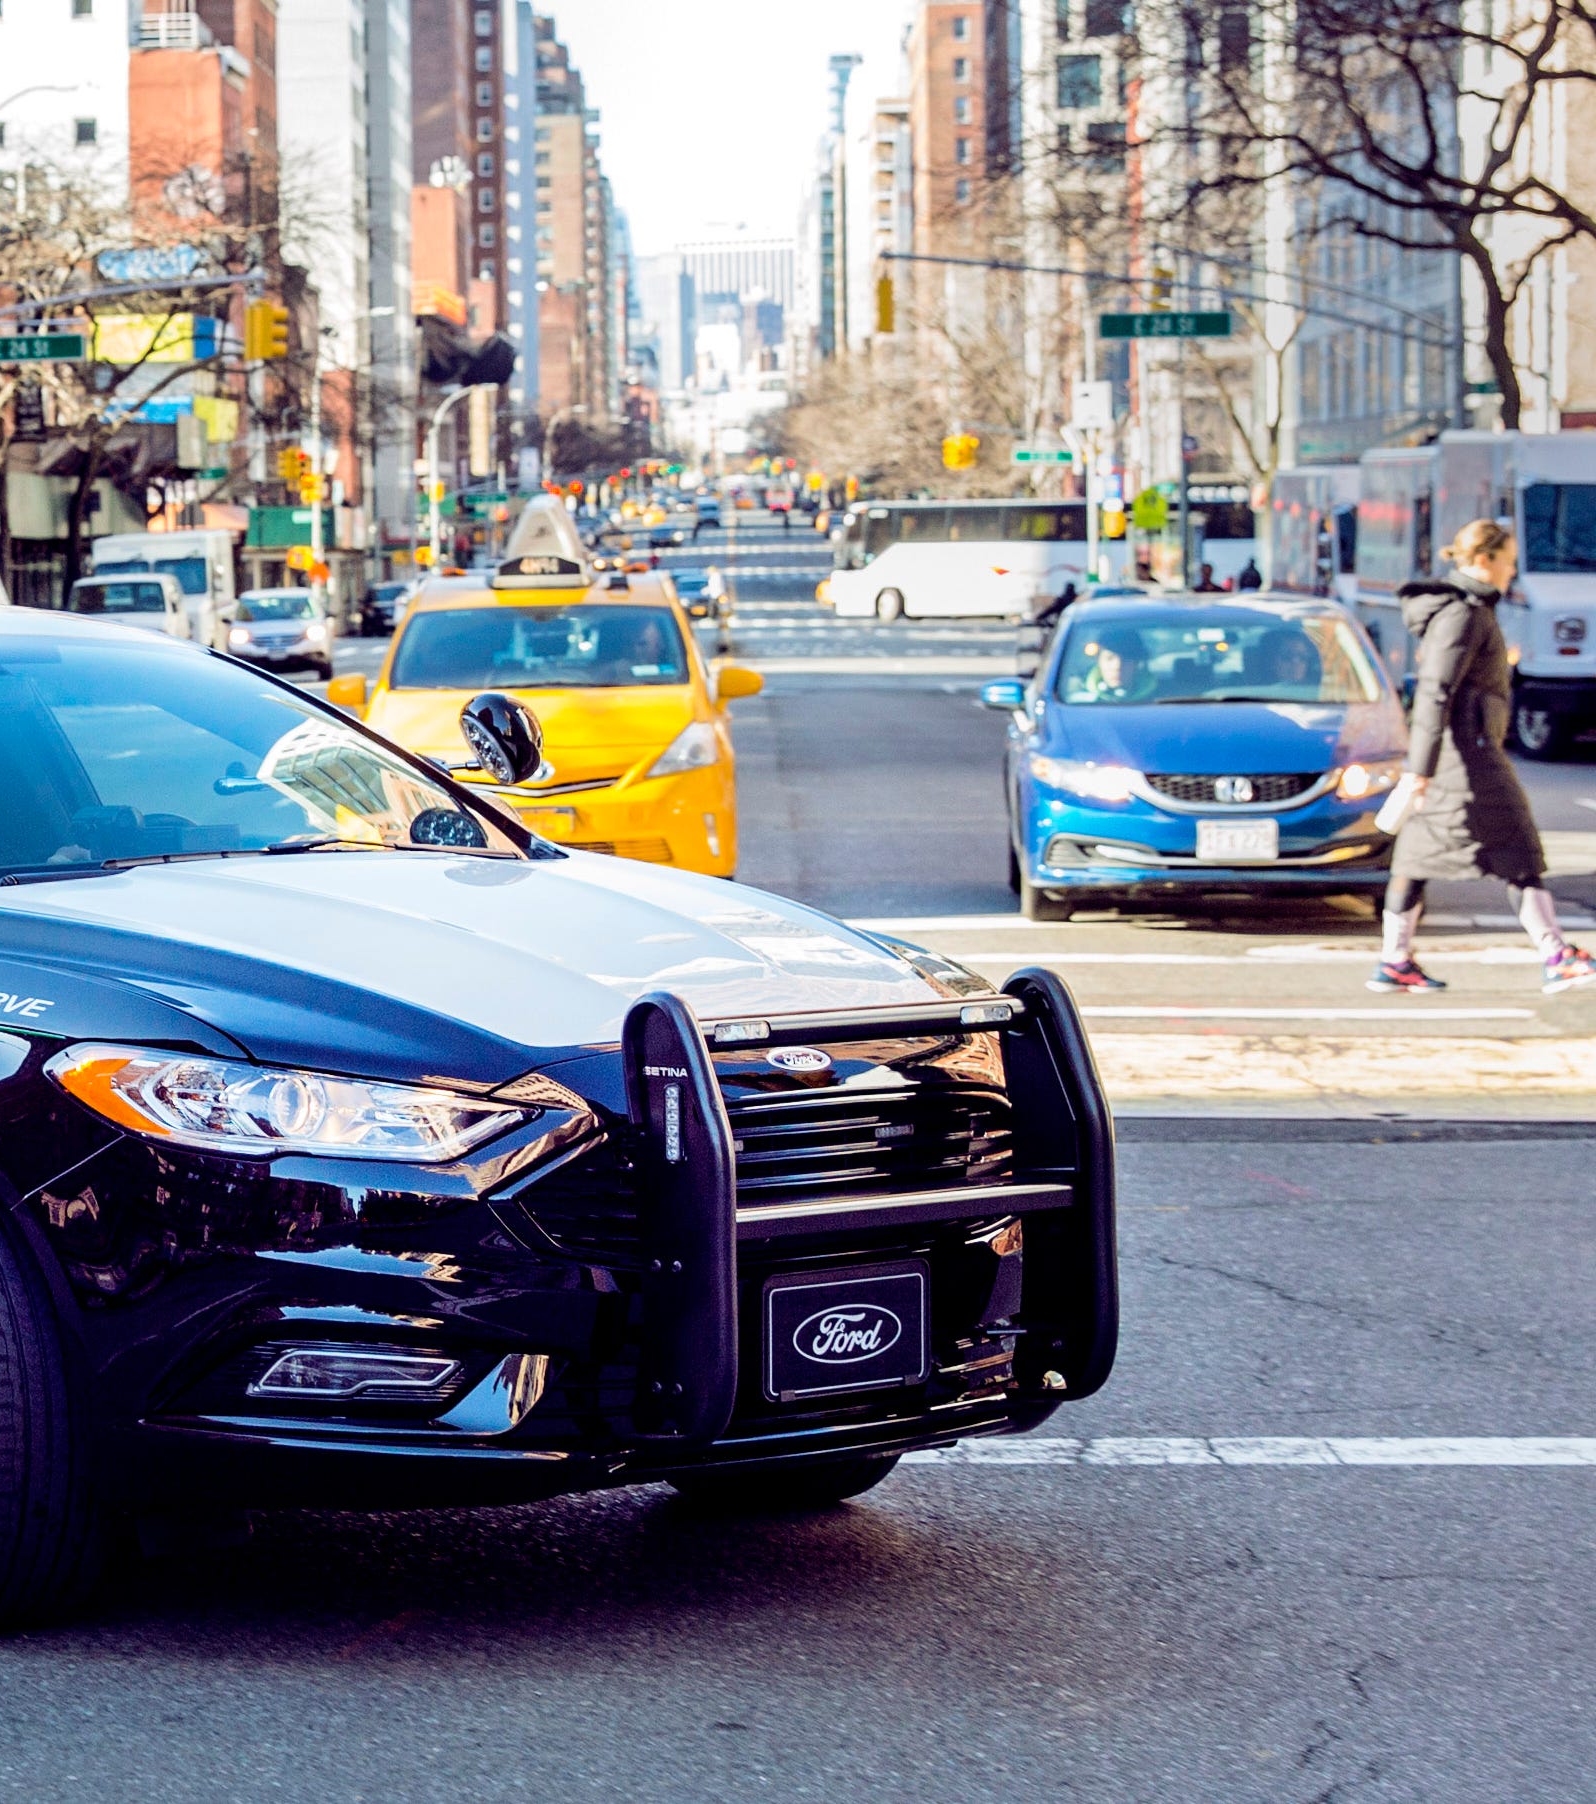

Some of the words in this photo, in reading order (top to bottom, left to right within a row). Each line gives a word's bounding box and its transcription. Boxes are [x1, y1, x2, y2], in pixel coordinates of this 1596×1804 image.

[10, 340, 28, 358] 24
[643, 1065, 689, 1078] SETINA
[812, 1312, 884, 1356] Ford
